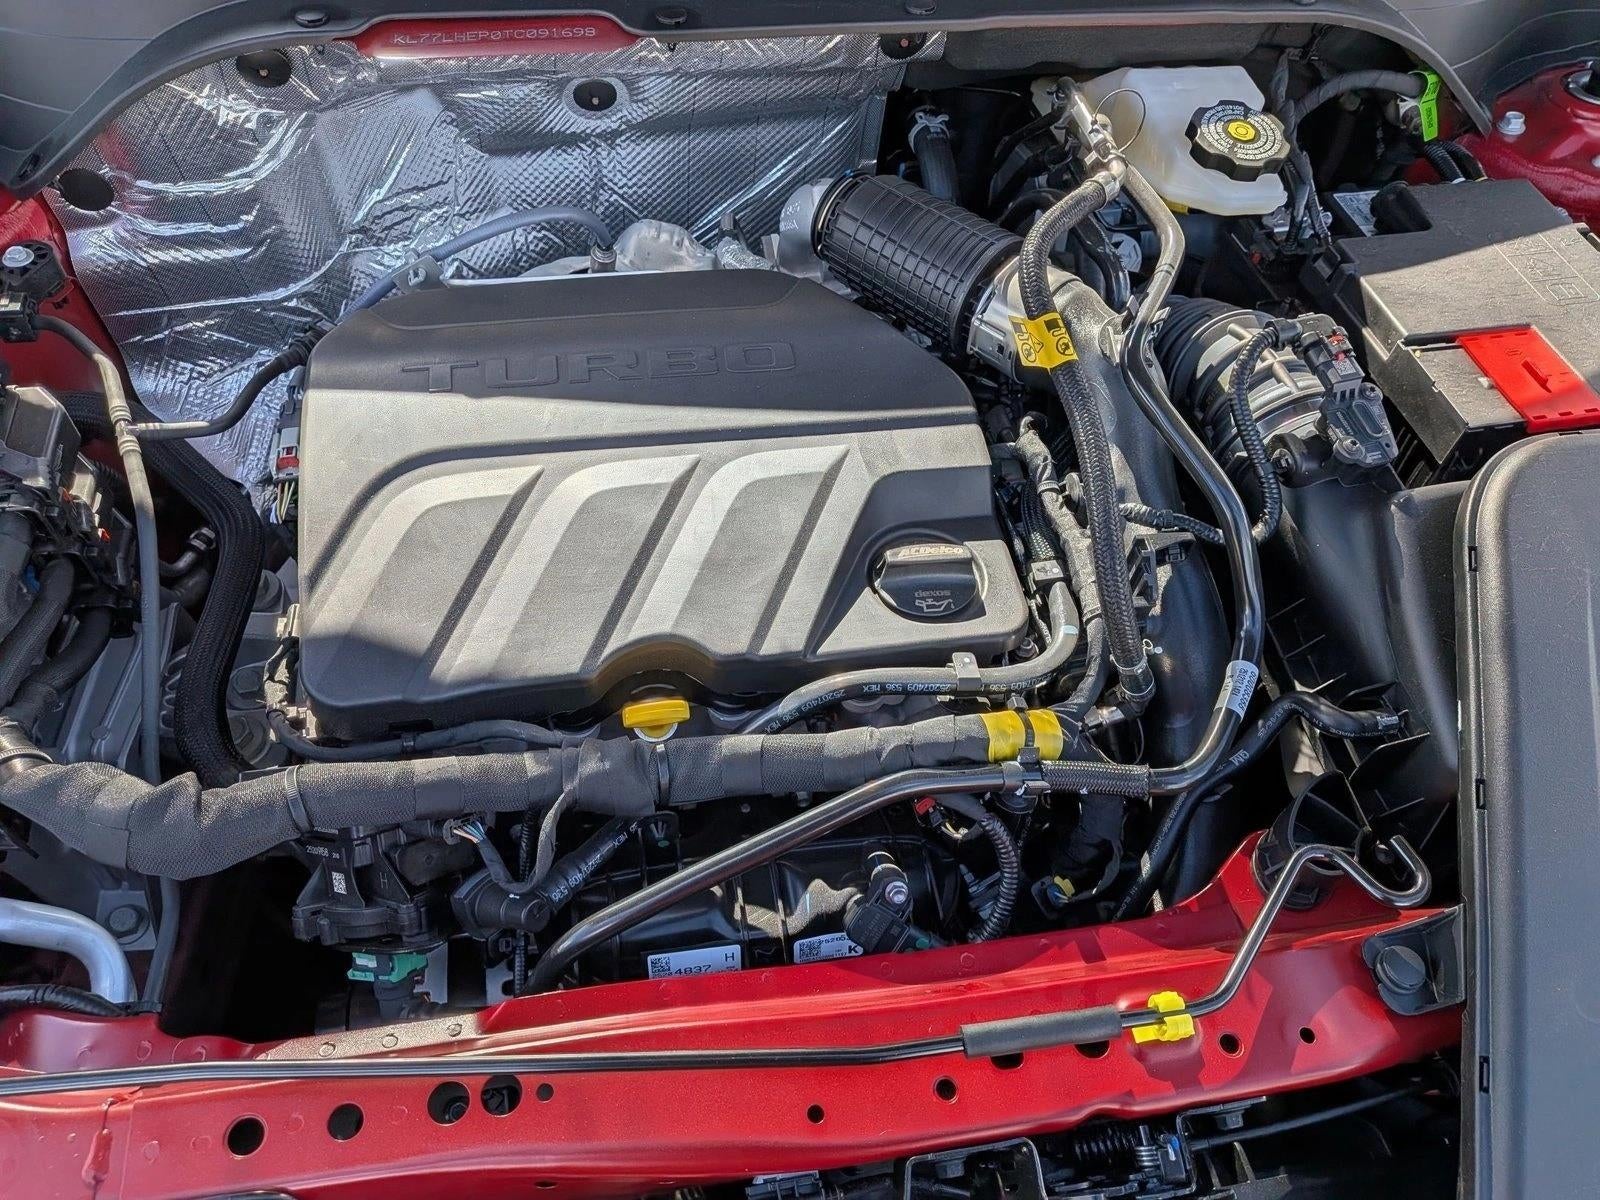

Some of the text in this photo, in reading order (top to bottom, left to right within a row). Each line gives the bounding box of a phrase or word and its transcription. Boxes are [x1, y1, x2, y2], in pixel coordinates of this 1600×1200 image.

[392, 27, 596, 44] KL77LHEP0TC091698
[401, 342, 797, 393] TURBO
[914, 589, 951, 598] dexos
[863, 683, 952, 693] 25207409 536 MEX
[765, 688, 847, 734] 25207409 536 MEX
[551, 886, 568, 902] 536
[848, 945, 859, 954] K
[724, 952, 735, 962] H
[674, 964, 712, 976] 4837
